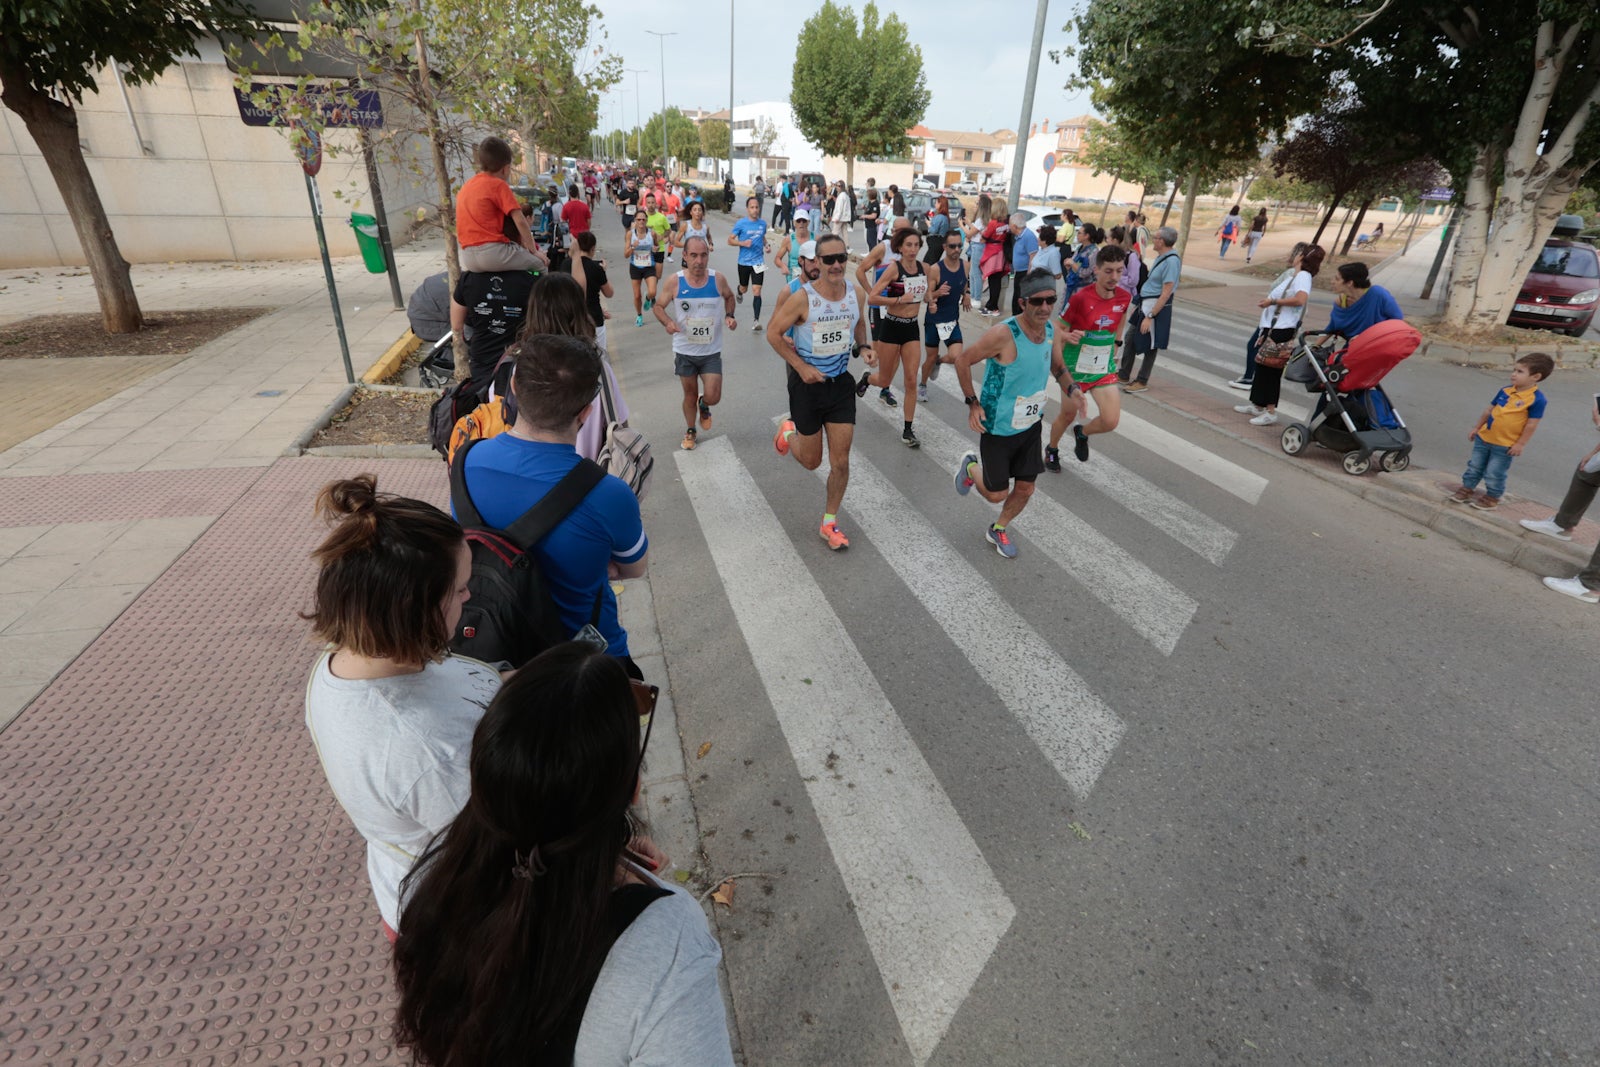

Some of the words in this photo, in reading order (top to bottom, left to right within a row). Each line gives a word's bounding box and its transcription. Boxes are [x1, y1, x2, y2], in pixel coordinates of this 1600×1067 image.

[692, 327, 709, 336] 261
[821, 331, 842, 344] 555
[1093, 355, 1098, 364] 1
[1025, 404, 1039, 416] 28
